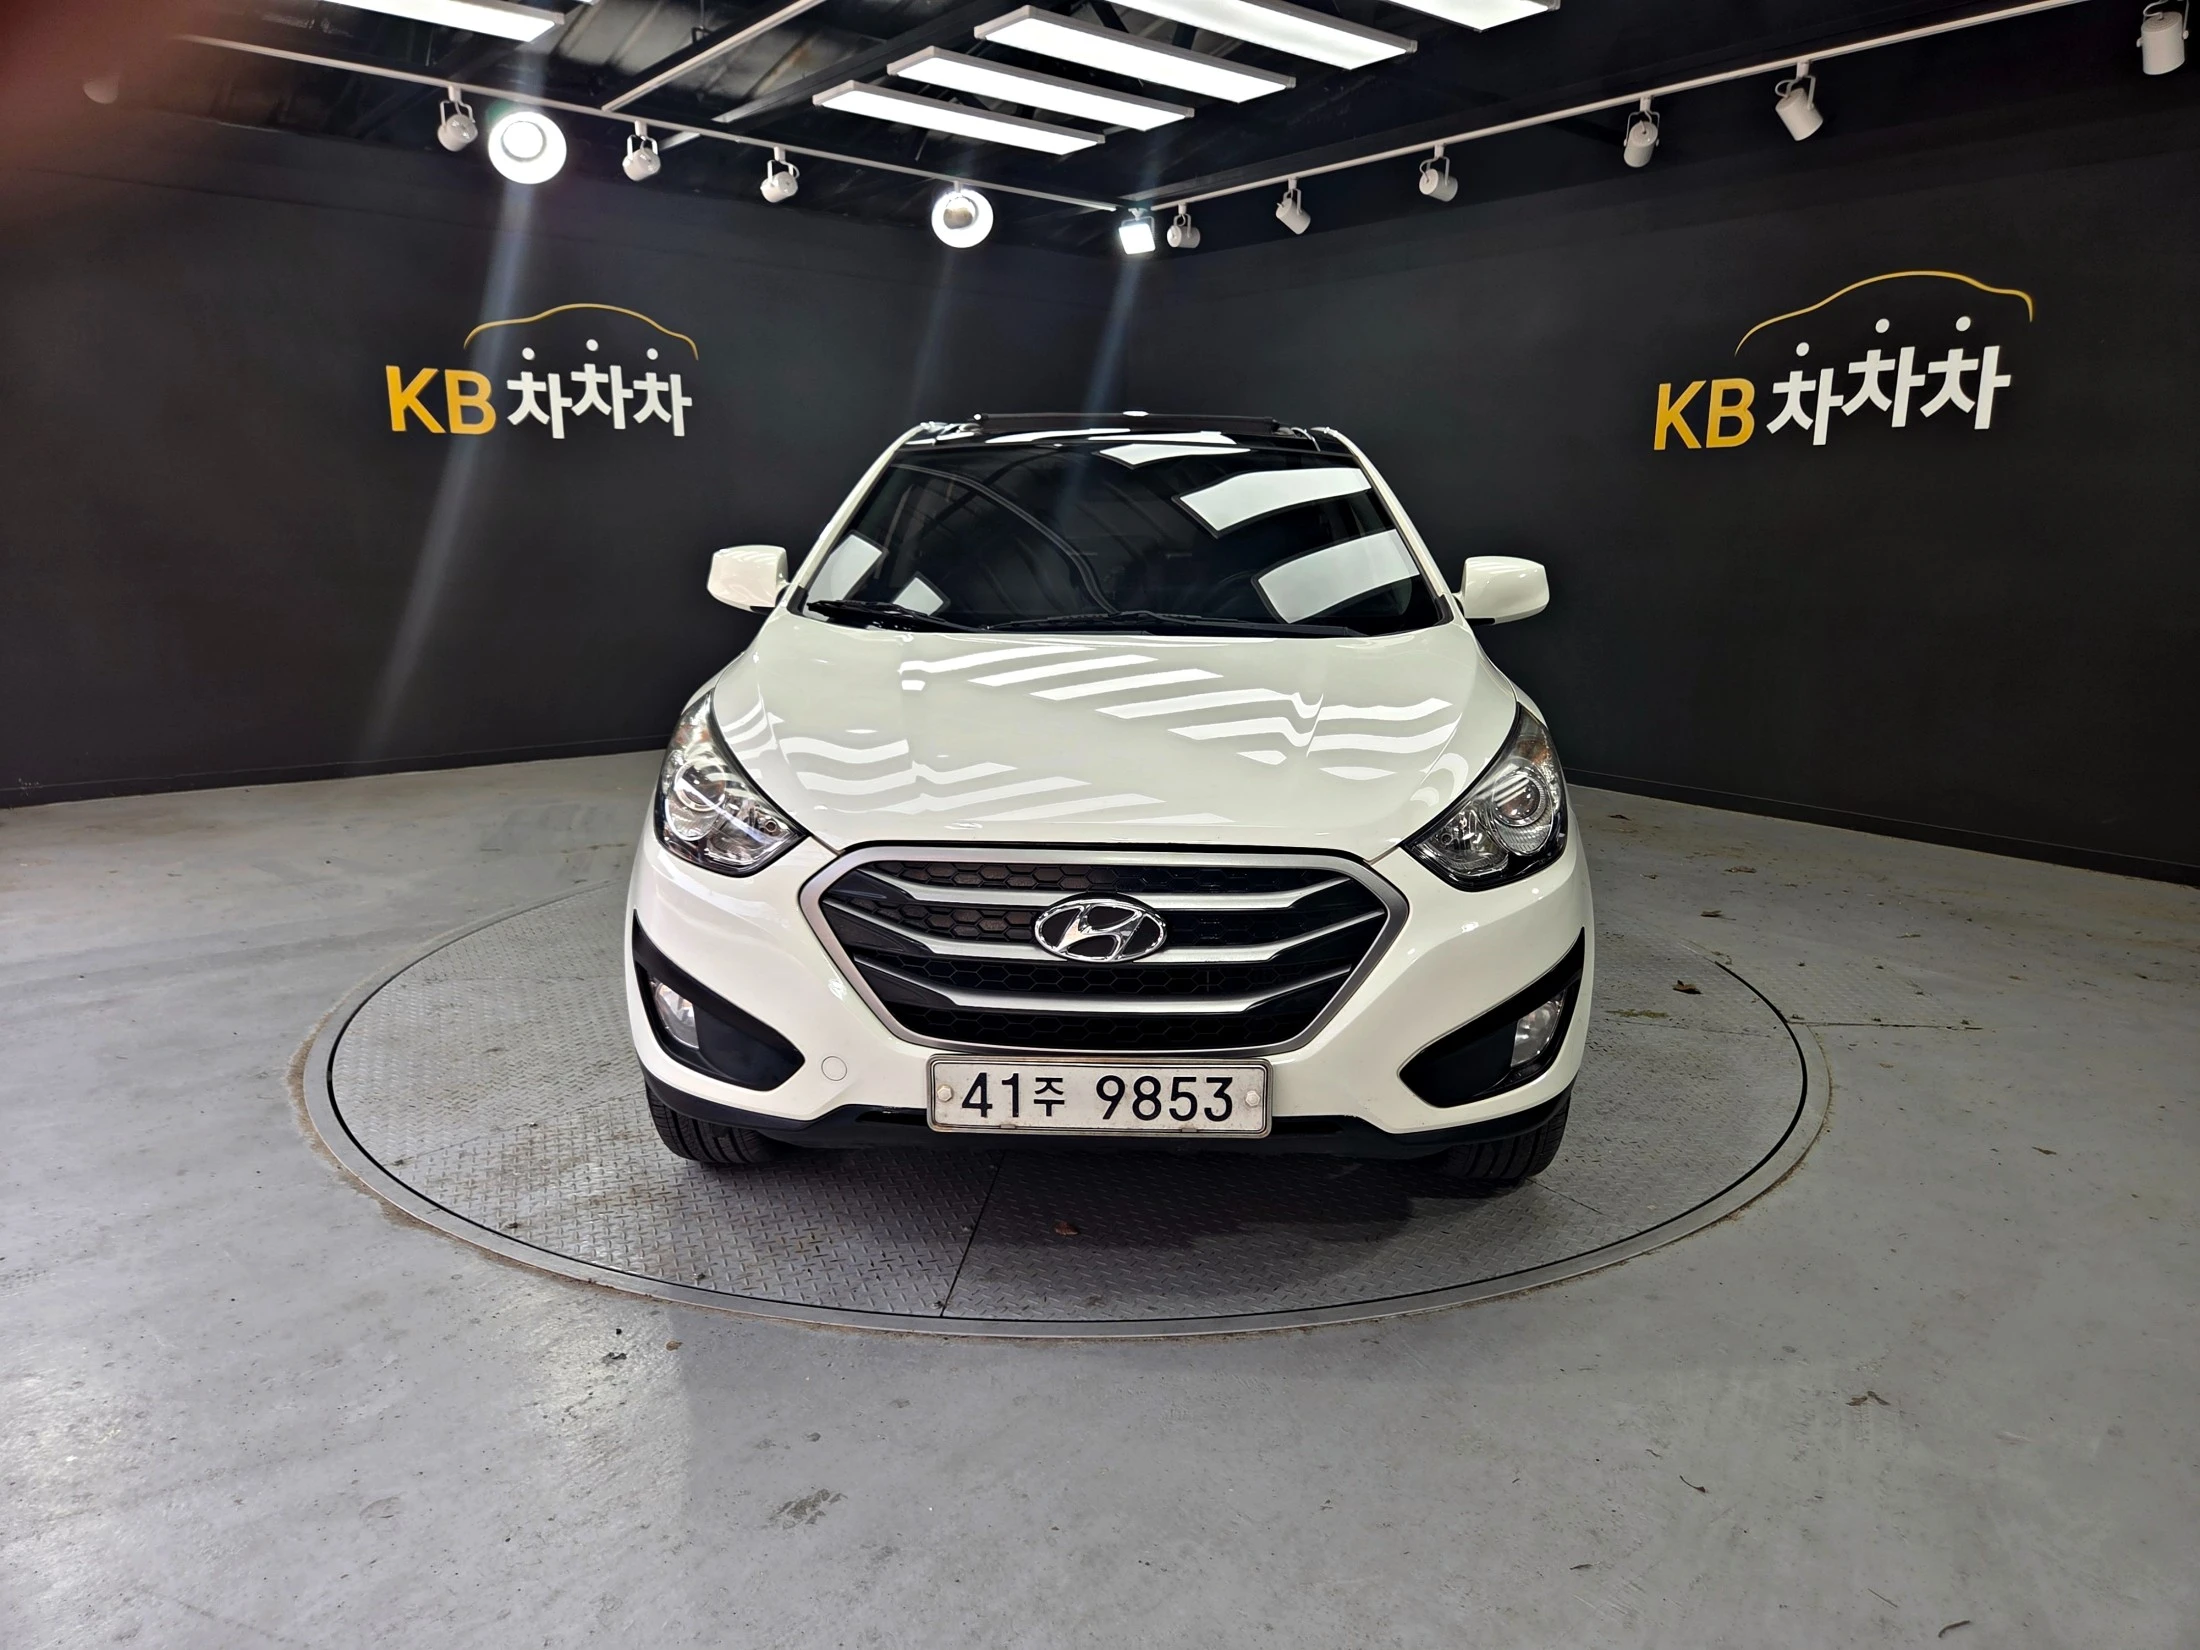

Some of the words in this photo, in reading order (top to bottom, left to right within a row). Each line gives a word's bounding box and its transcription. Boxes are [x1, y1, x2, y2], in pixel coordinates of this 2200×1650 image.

[385, 365, 497, 435] KB
[506, 338, 693, 440] 차차차
[1653, 377, 1756, 451] KB
[1765, 315, 2012, 447] 차차차
[961, 1072, 1066, 1119] 41주
[1095, 1074, 1234, 1122] 9853
